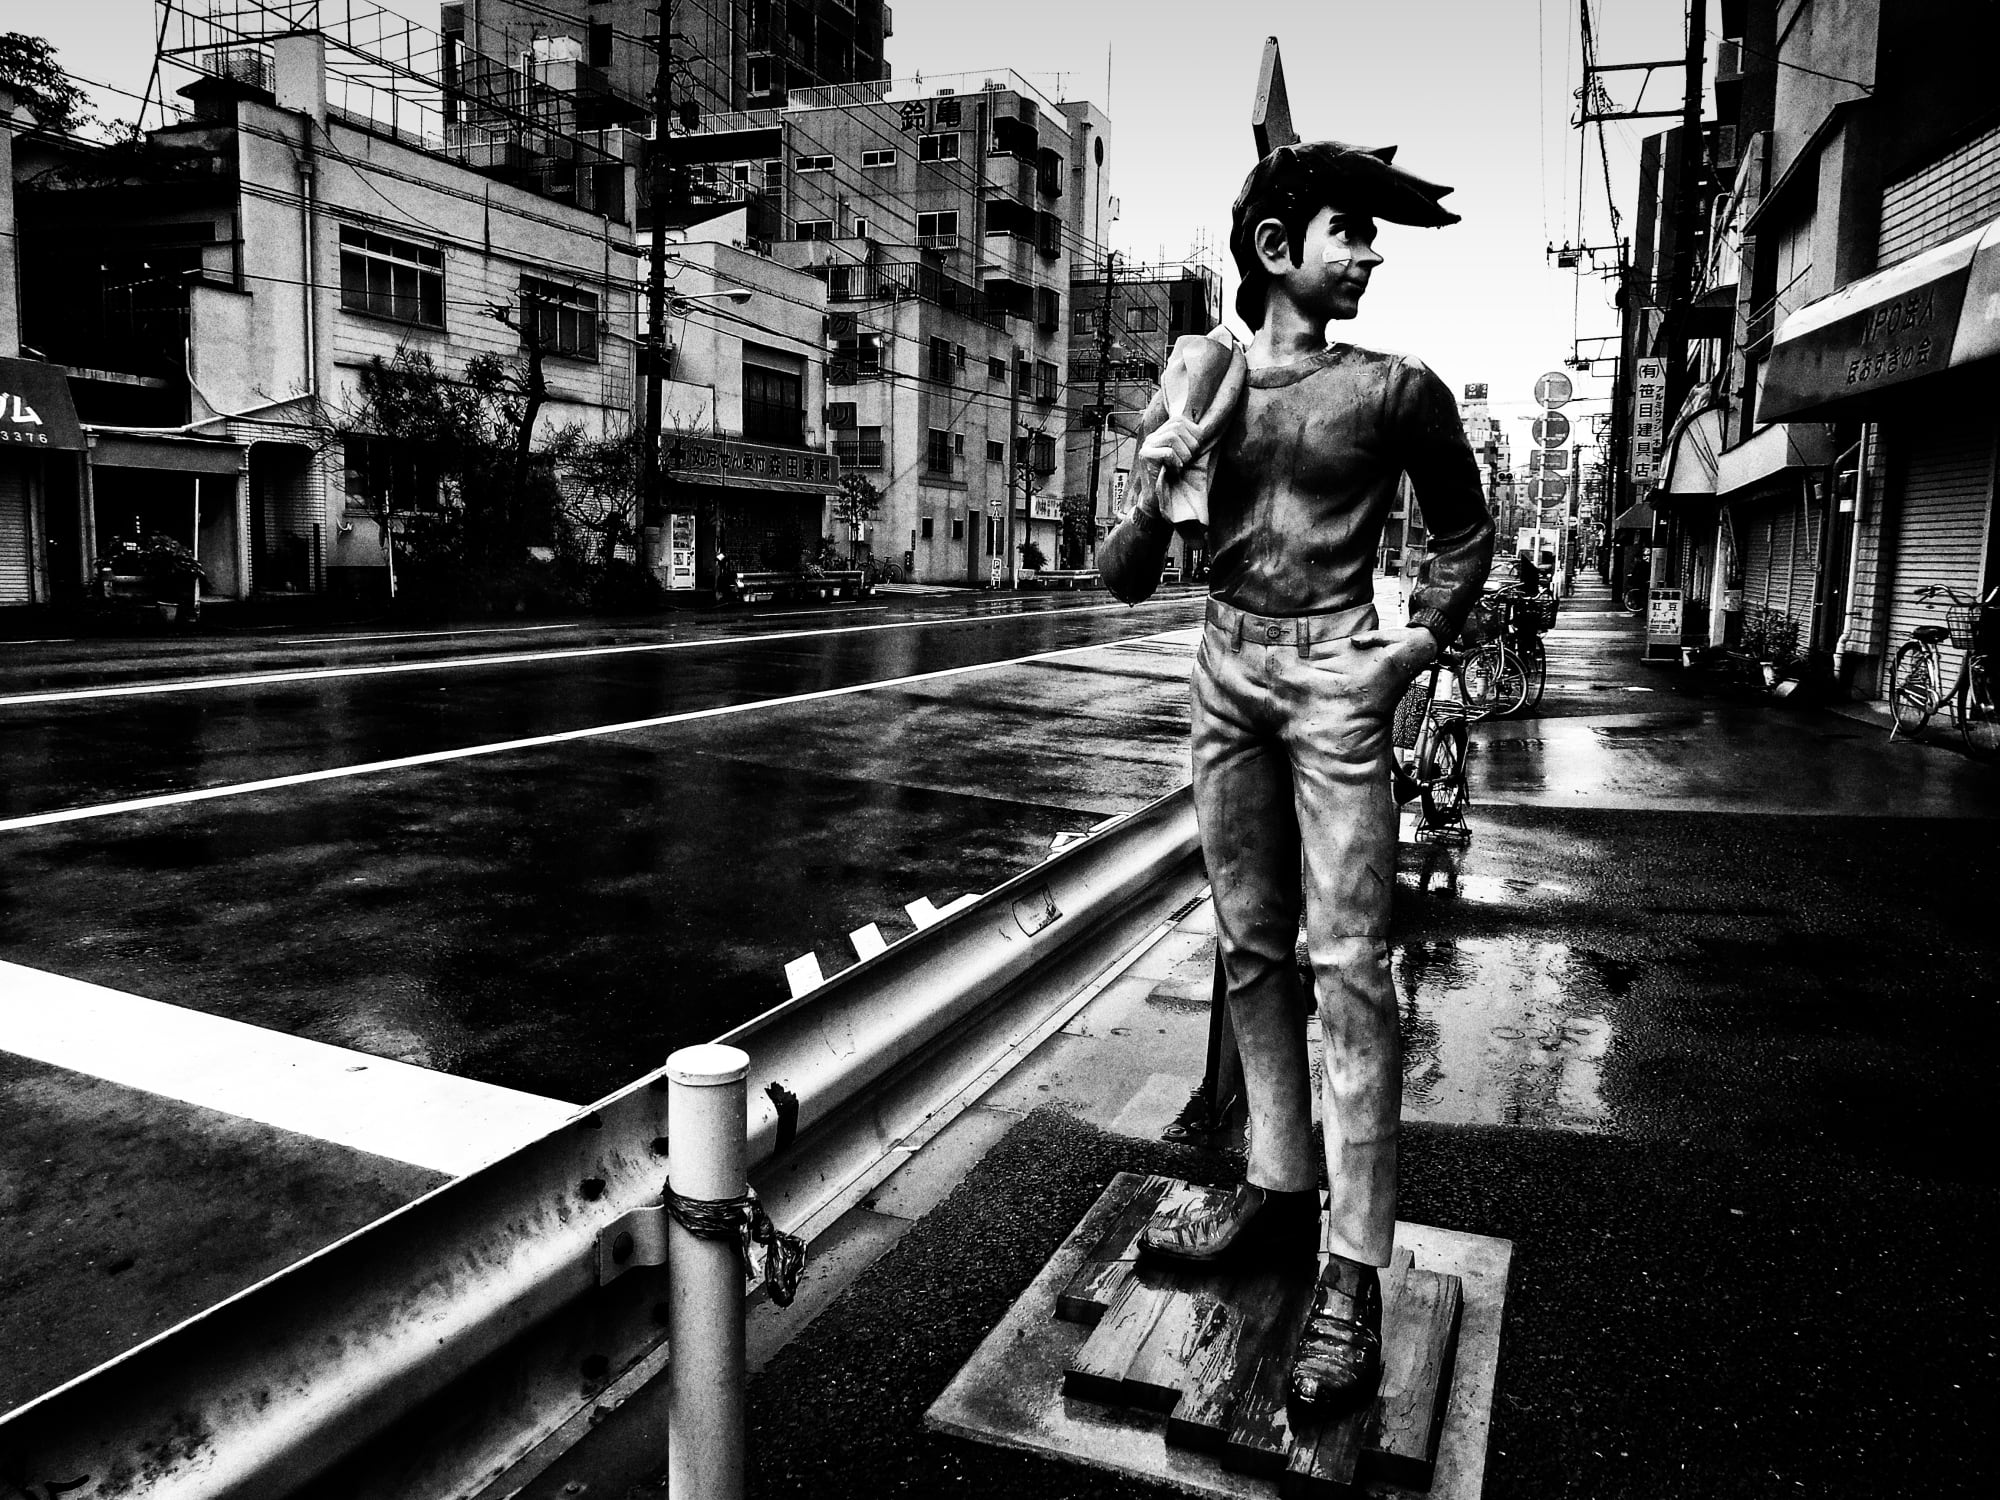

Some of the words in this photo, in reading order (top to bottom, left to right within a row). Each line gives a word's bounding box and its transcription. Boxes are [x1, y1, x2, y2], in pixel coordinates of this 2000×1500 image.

[0, 430, 48, 444] 3376
[769, 453, 830, 481] 森田薬局
